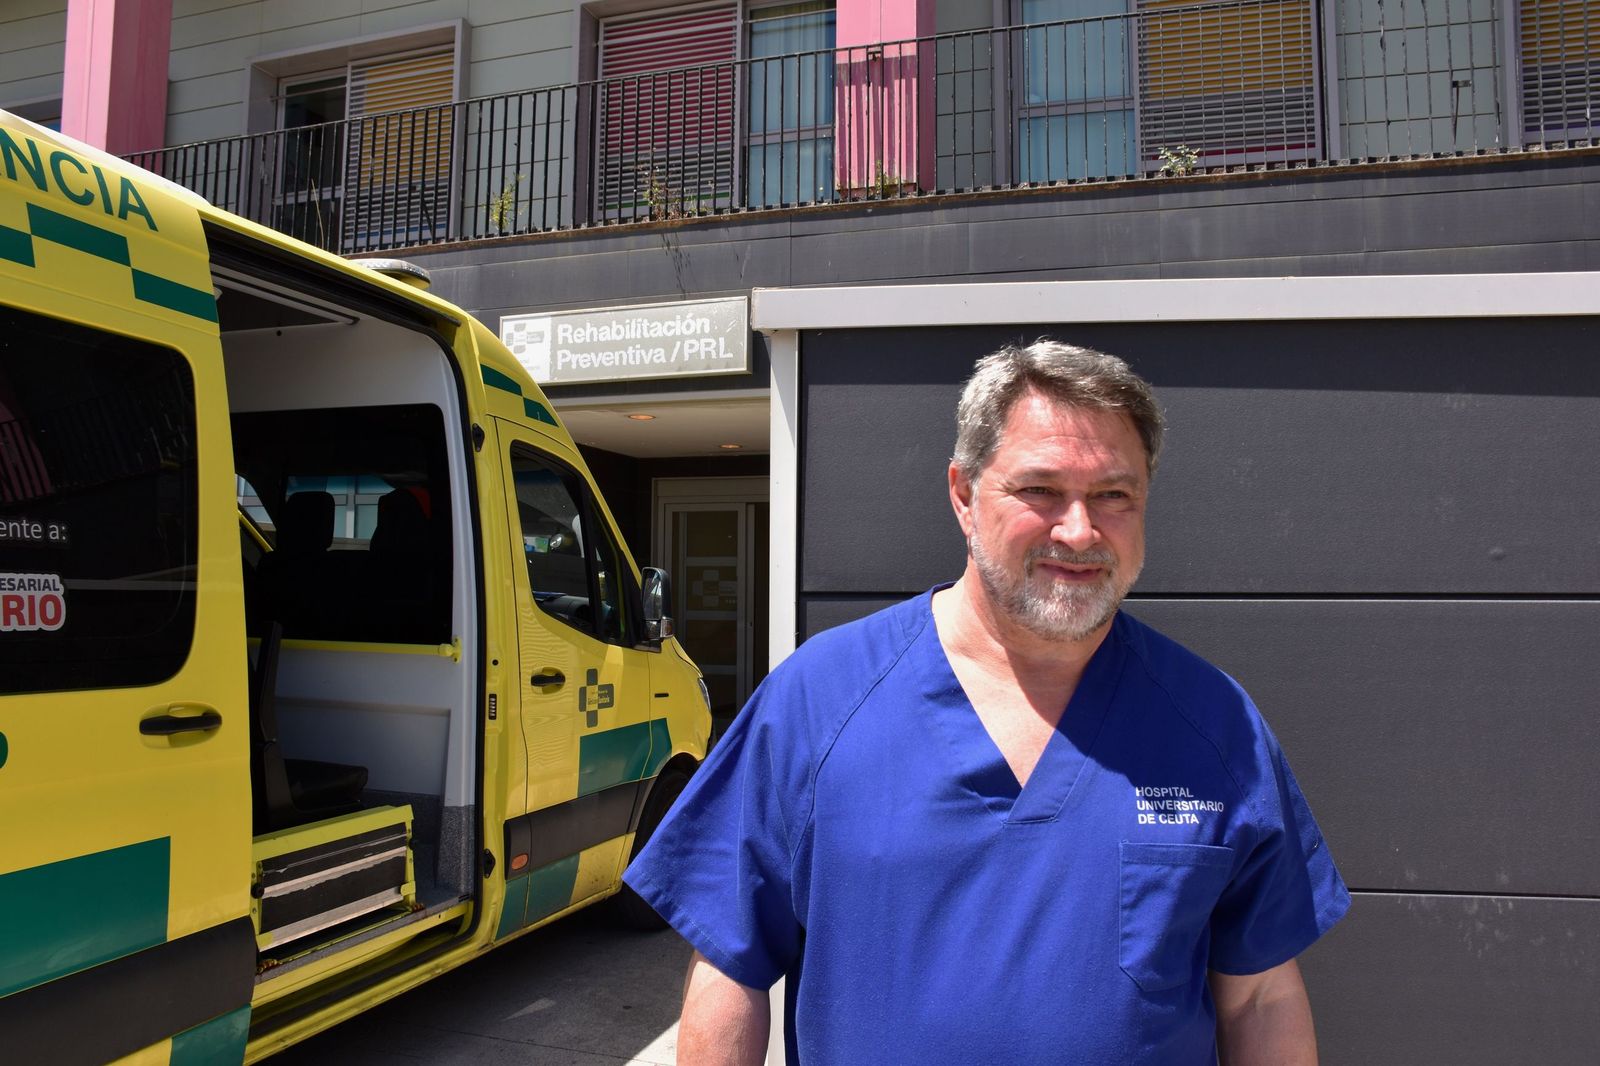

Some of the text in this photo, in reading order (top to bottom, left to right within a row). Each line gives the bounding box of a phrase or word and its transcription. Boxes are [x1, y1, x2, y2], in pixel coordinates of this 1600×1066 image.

[557, 313, 710, 344] Rehabilitación
[557, 344, 665, 370] Preventiva
[49, 524, 66, 540] a:
[0, 578, 60, 592] ESARIAL
[2, 594, 62, 626] RIO
[1135, 786, 1194, 798] HOSPITAL
[1136, 800, 1224, 812] UNIVERSITARIO
[1138, 813, 1199, 825] DE CEUTA
